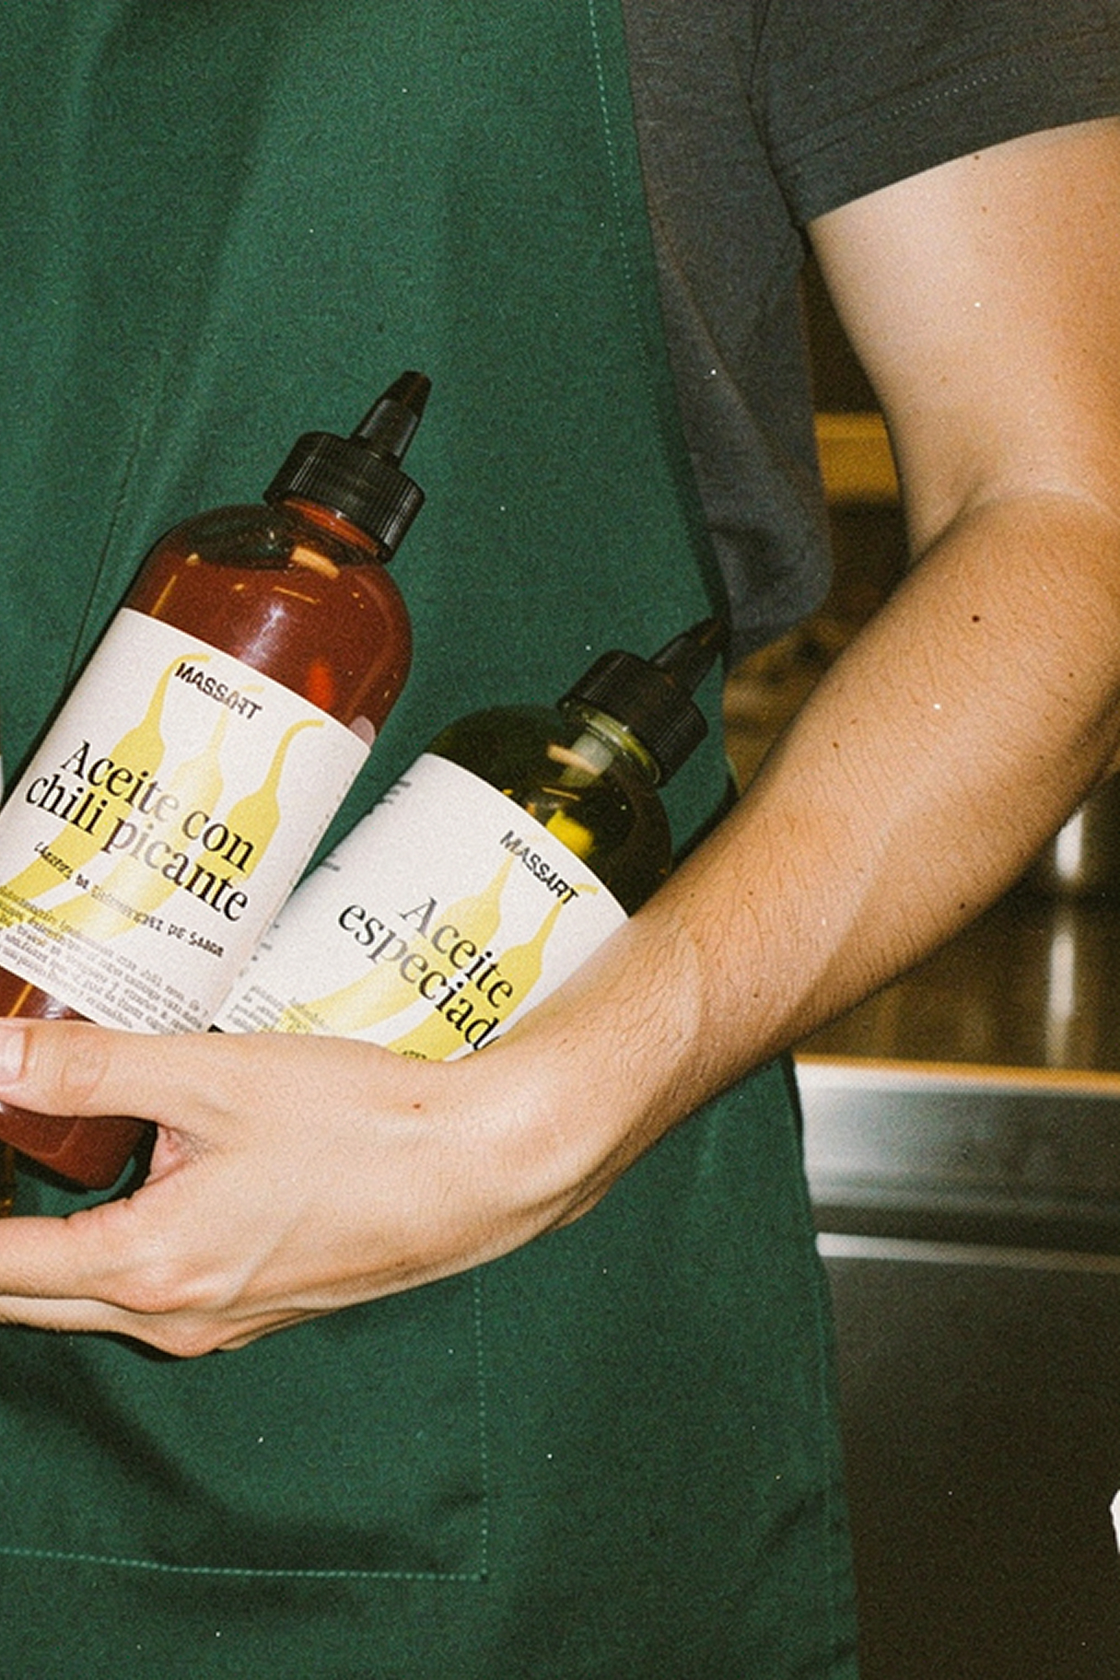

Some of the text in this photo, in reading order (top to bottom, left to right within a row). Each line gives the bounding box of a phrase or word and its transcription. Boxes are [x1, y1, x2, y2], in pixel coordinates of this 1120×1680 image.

[174, 663, 262, 720] MASSART
[25, 774, 109, 836] chili
[102, 816, 250, 923] picante
[60, 740, 255, 872] Aceite con
[499, 831, 578, 904] MASSART
[338, 905, 500, 1050] especiad
[399, 896, 514, 1008] Aceite
